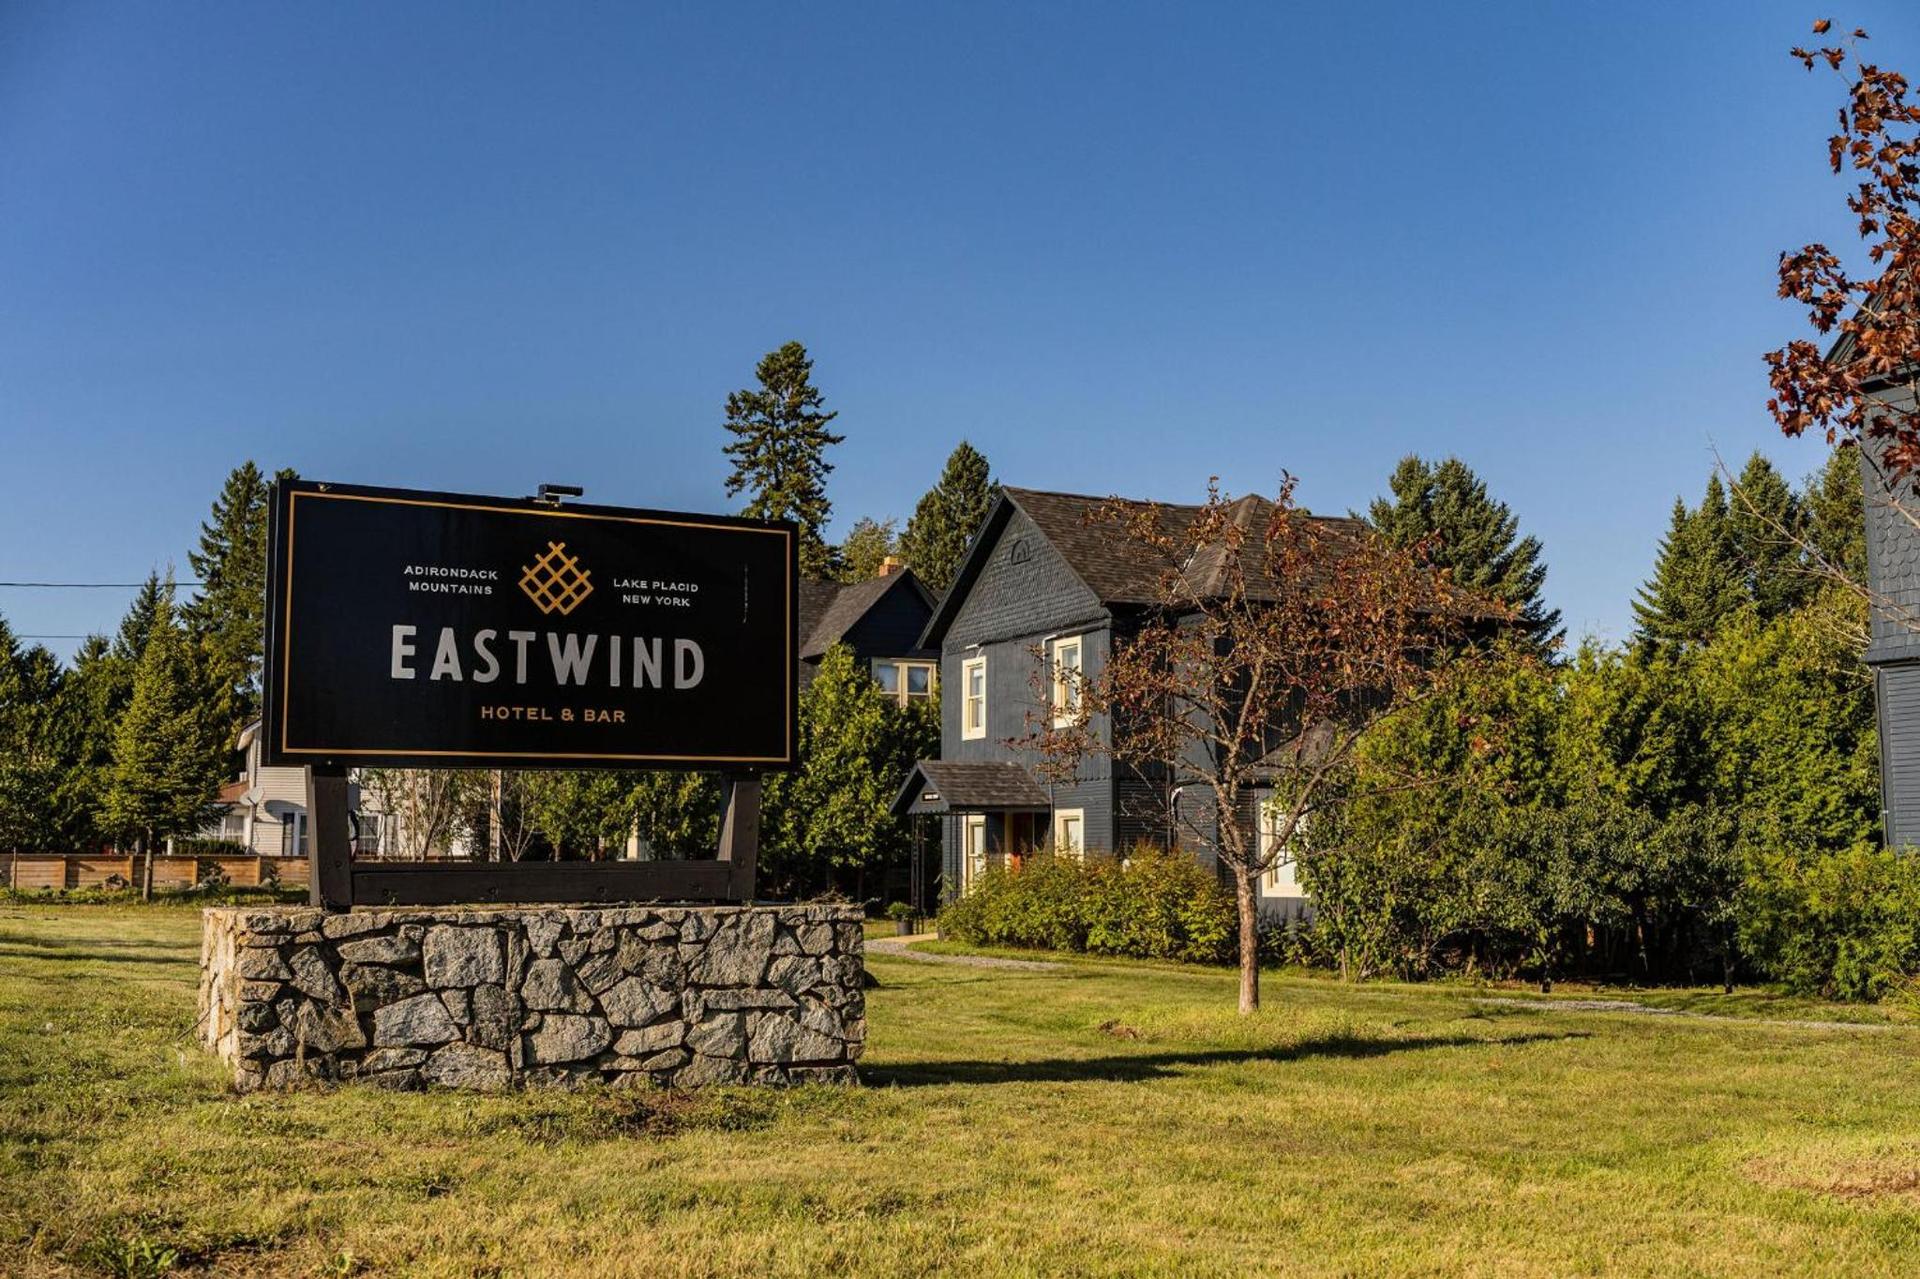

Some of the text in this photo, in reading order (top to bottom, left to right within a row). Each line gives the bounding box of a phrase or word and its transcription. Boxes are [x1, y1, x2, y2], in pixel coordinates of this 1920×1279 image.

[403, 565, 498, 580] ADIRONDACK
[409, 581, 492, 595] MOUNTAINS
[612, 578, 699, 593] LAKE PLACID
[622, 594, 690, 607] NEW YORK
[390, 624, 705, 690] EASTWIND
[481, 706, 626, 723] HOTEL & BAR
